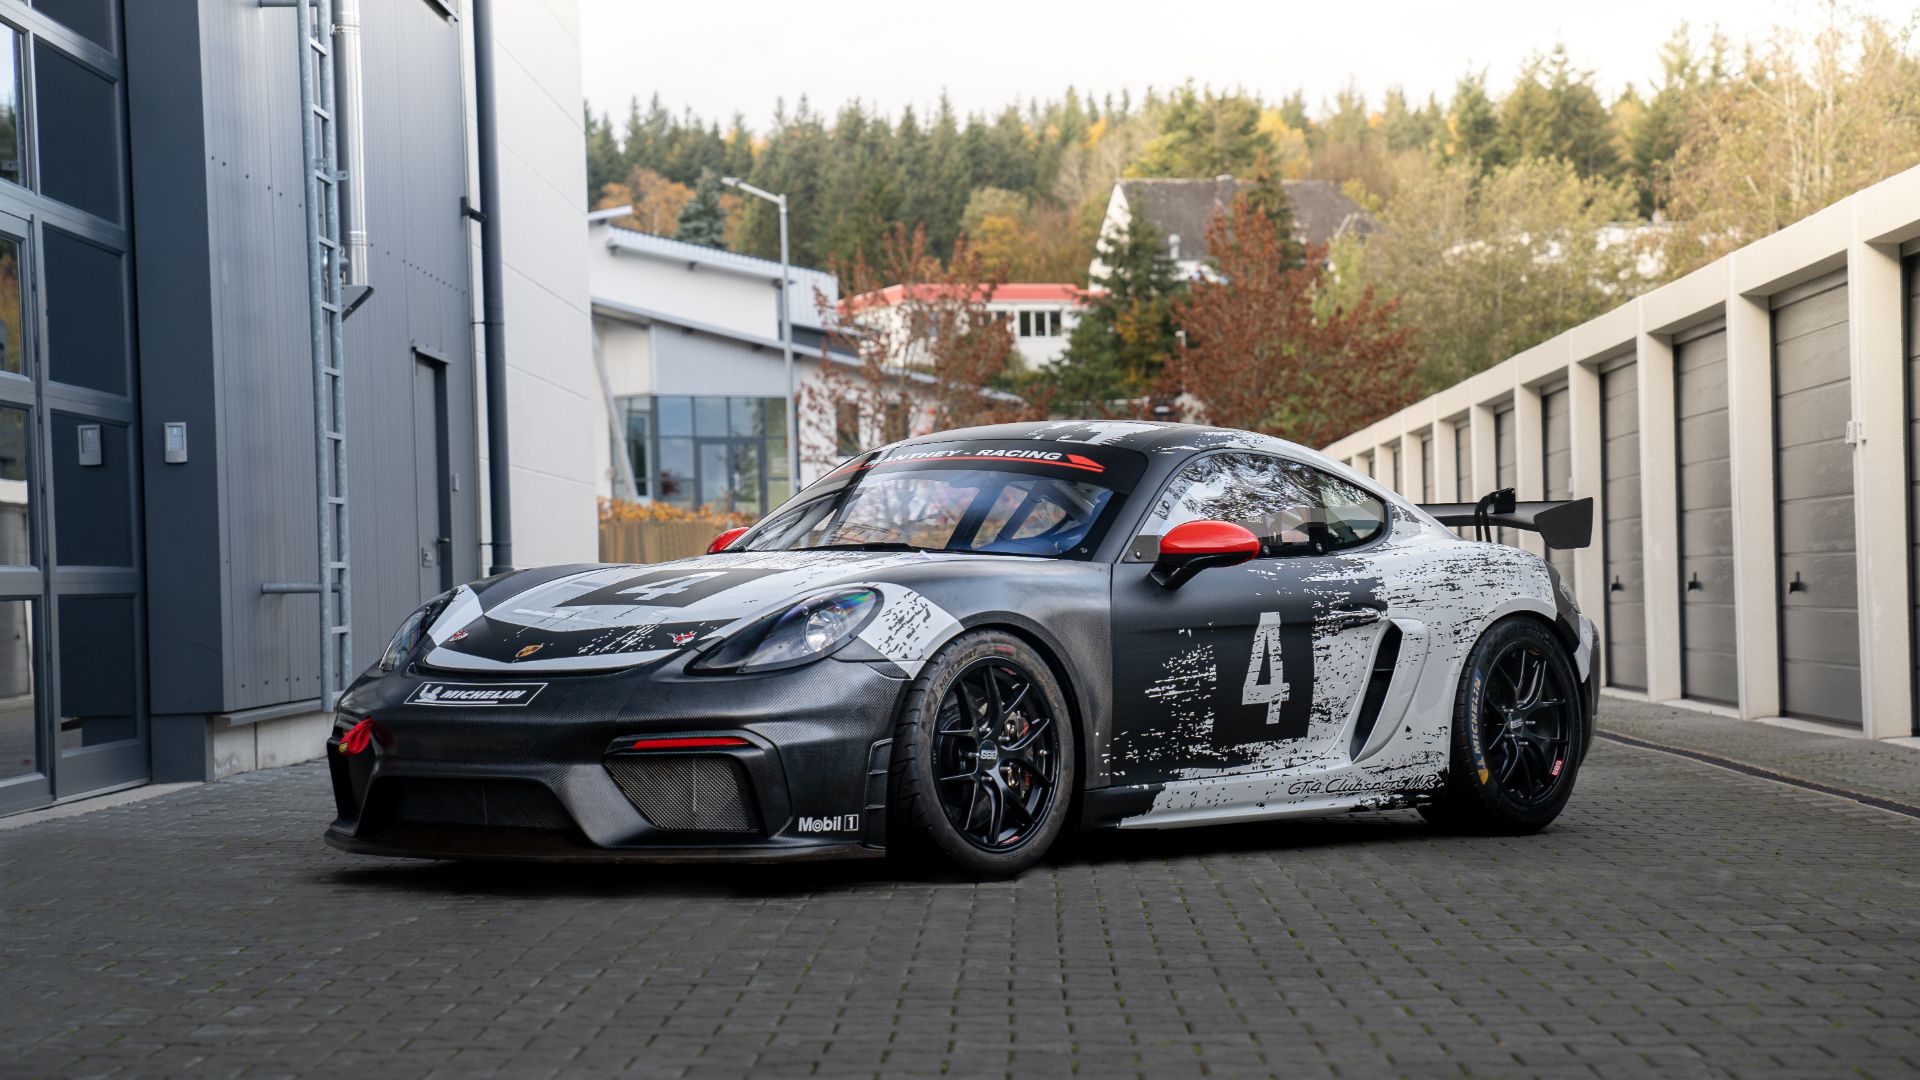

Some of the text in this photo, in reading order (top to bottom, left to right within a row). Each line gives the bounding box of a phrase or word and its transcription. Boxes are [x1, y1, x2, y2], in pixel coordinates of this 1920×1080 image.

[864, 449, 964, 467] MANTHEY
[976, 449, 1062, 461] RACING
[613, 571, 729, 601] 4
[1242, 611, 1291, 725] 4
[439, 689, 528, 700] MICHELIN
[1470, 676, 1482, 754] MICHELIN
[1287, 772, 1439, 795] GT4 Clubsport MR
[798, 815, 842, 832] Mobil
